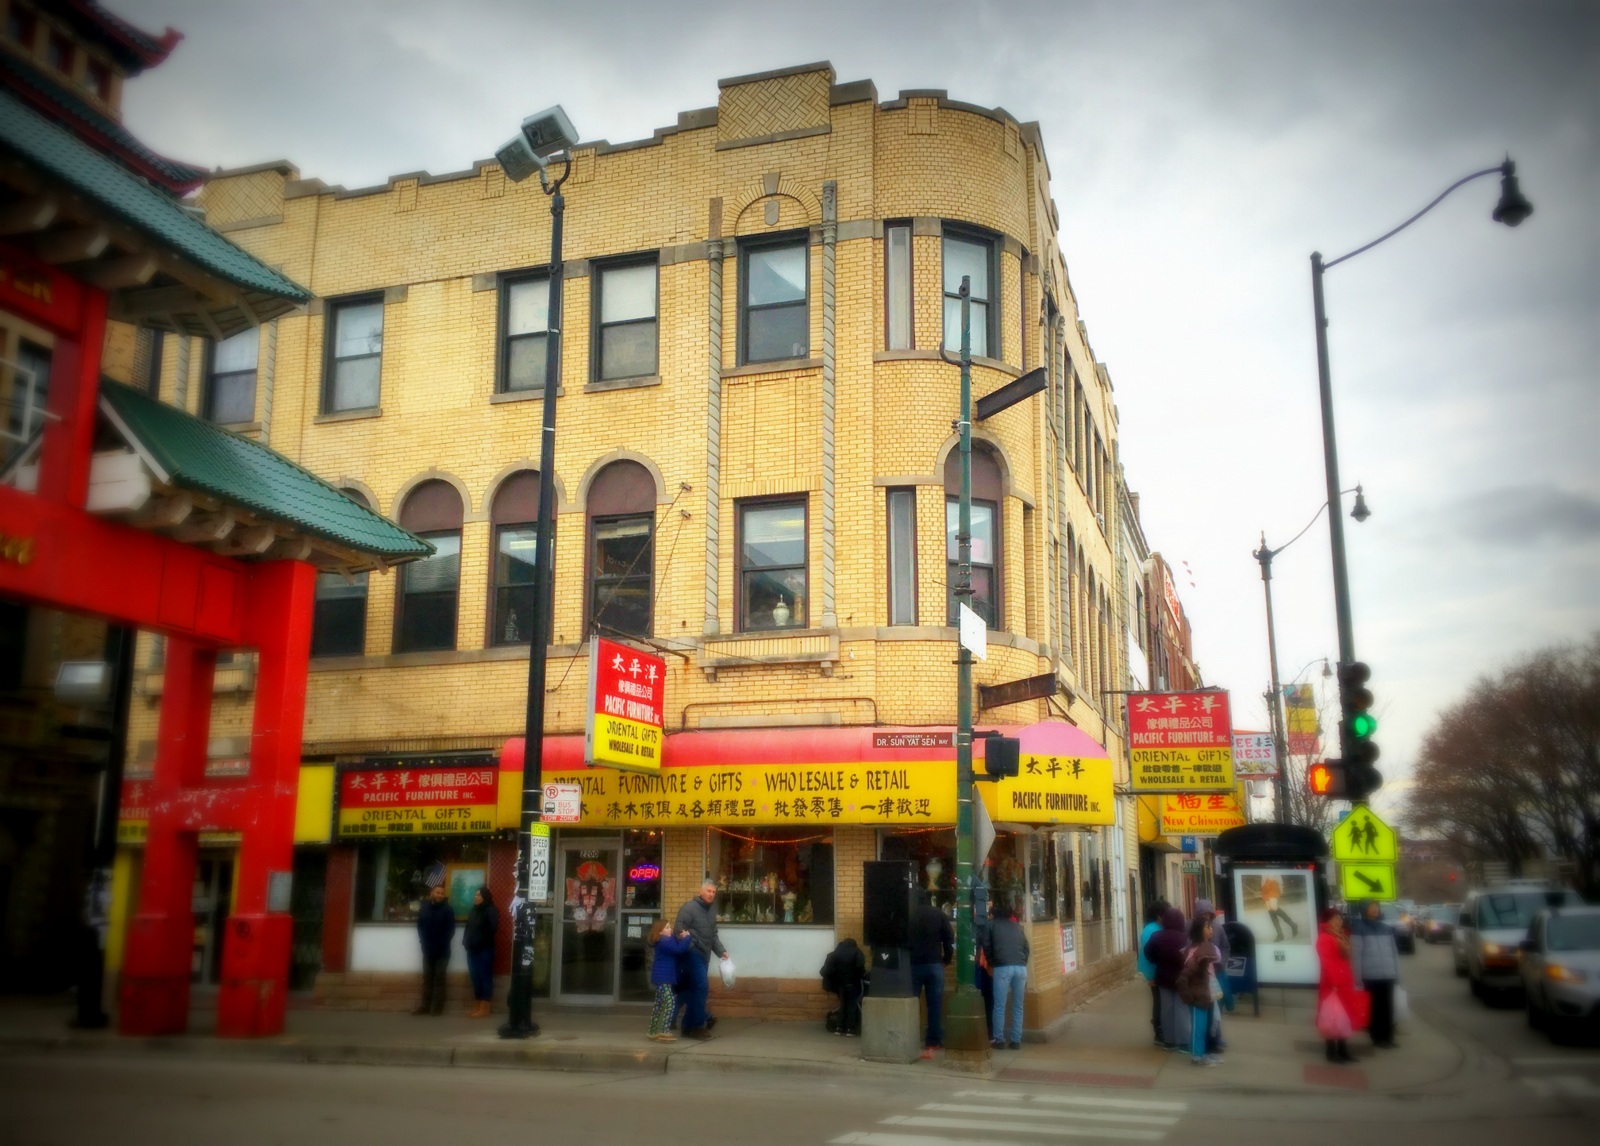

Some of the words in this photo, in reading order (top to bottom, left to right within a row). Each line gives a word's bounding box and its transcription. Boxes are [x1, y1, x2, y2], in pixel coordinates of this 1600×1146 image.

[612, 653, 658, 685] 太平洋
[604, 694, 625, 716] PACIFIC
[626, 698, 653, 723] FURNITURE
[1135, 695, 1222, 714] 太平洋
[607, 720, 639, 740] ORIENTAL
[641, 727, 658, 744] GIFTS
[1133, 732, 1164, 744] PACIFIC
[1167, 731, 1214, 744] FURNITURE
[608, 738, 634, 755] WHOLESALE
[640, 744, 655, 759] RETAIL
[876, 738, 888, 746] DR.
[890, 738, 905, 746] SUN
[907, 738, 919, 746] YAT
[921, 738, 936, 746] SEN
[1133, 750, 1191, 763] ORIENTAL
[1197, 750, 1230, 762] GIFTS
[1026, 757, 1085, 779] 太平洋
[350, 771, 414, 790] 太平洋
[618, 773, 687, 794] FURNITURE
[693, 775, 703, 791] &
[709, 771, 742, 793] GIFTS
[764, 770, 844, 792] WHOLESALE
[849, 773, 859, 789] &
[866, 769, 910, 791] RETAIL
[1140, 775, 1185, 784] WHOLESALE
[1189, 776, 1196, 784] &
[1200, 775, 1227, 784] RETAIL
[363, 792, 400, 803] PACIFIC
[405, 790, 459, 801] FURNITURE
[463, 791, 476, 799] INC.
[1012, 791, 1042, 810] PACIFIC
[1045, 792, 1088, 812] FURNITURE
[1090, 801, 1101, 813] INC.
[860, 796, 932, 818] 一律歡迎
[362, 809, 427, 822] ORIENTAL
[435, 807, 471, 819] GIFTS
[1163, 816, 1184, 826] NEW
[422, 821, 458, 831] WHOLESALE
[462, 822, 467, 830] &
[470, 820, 491, 830] RETAIL
[532, 824, 549, 835] SCHOOL
[532, 838, 548, 848] SPEED
[533, 849, 546, 858] LIMIT
[532, 859, 547, 877] 20
[1183, 860, 1200, 869] ATM
[629, 868, 660, 878] OPEN
